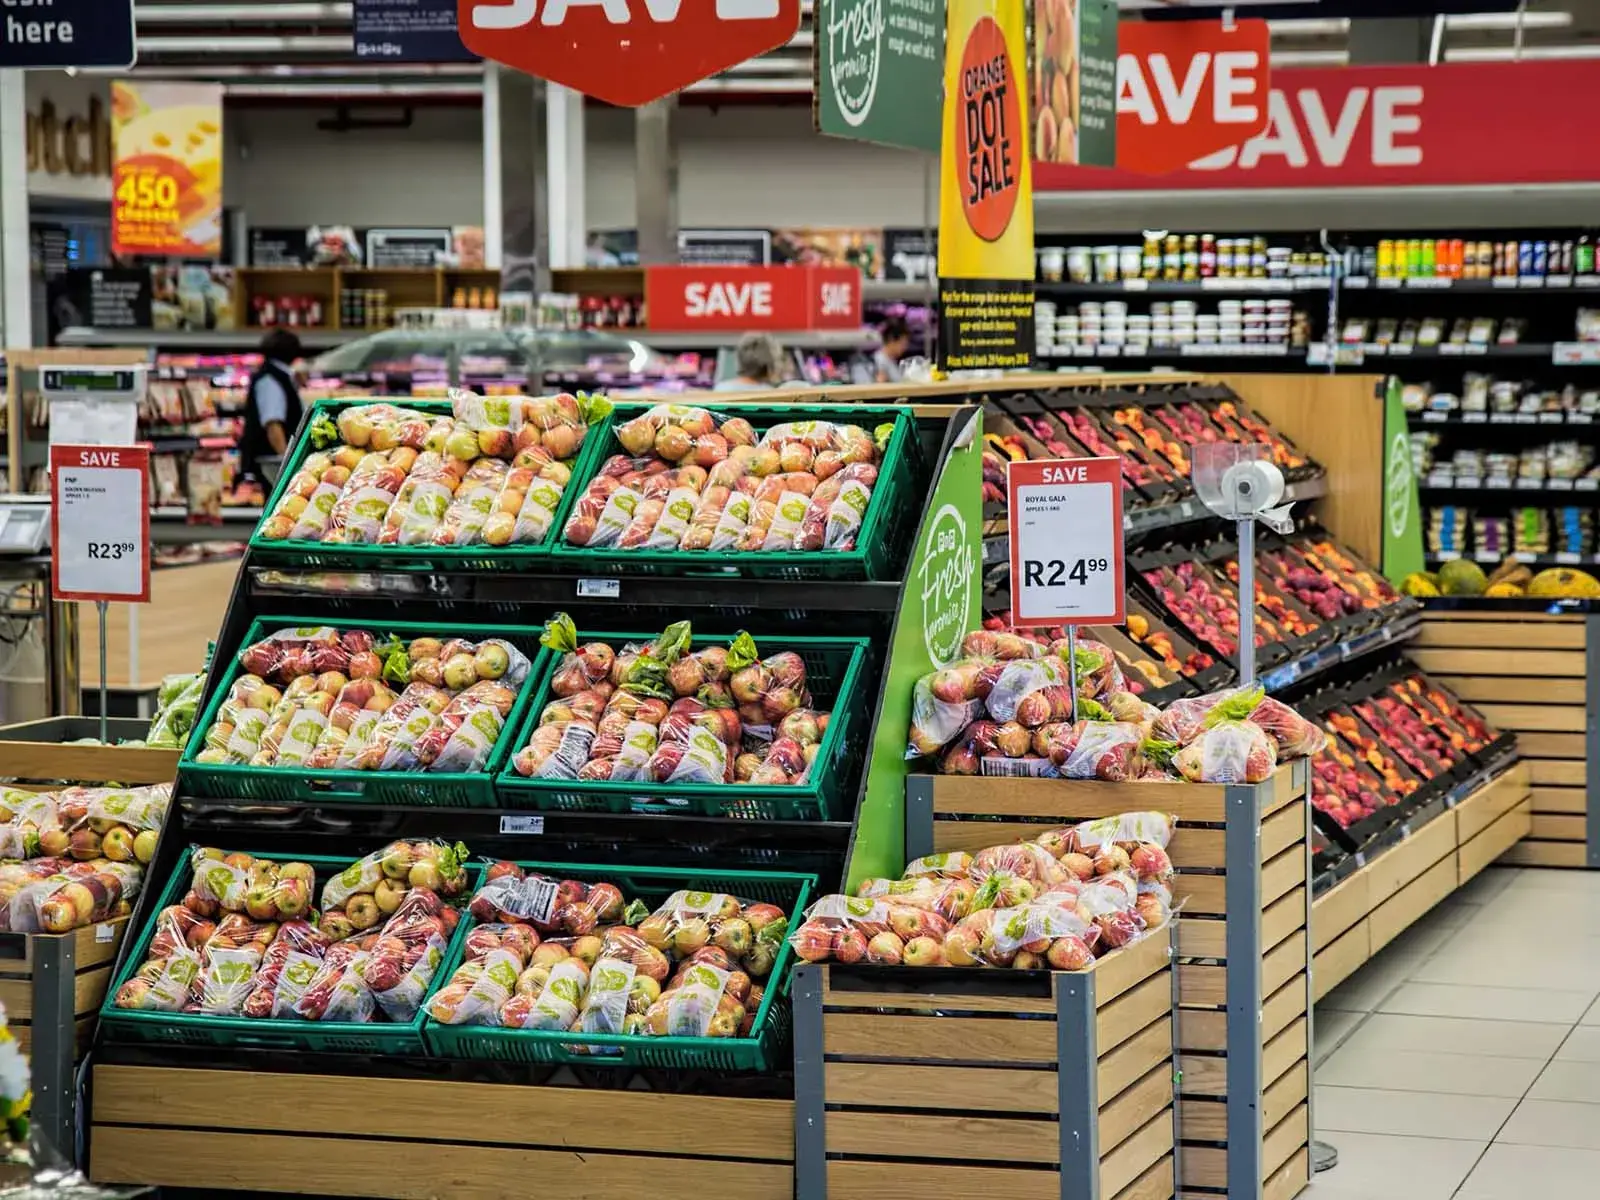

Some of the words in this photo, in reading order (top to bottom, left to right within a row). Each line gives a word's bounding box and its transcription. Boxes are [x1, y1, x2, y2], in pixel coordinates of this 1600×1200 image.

[7, 14, 73, 43] here
[965, 53, 1007, 98] ORANGE
[1116, 51, 1259, 125] AVE
[966, 84, 1007, 155] DOT
[1187, 85, 1425, 170] AVE
[116, 175, 178, 208] 450
[968, 140, 1014, 205] SALE
[685, 281, 773, 317] SAVE
[80, 451, 120, 466] SAVE
[1042, 466, 1088, 483] SAVE
[918, 520, 976, 612] Fresh
